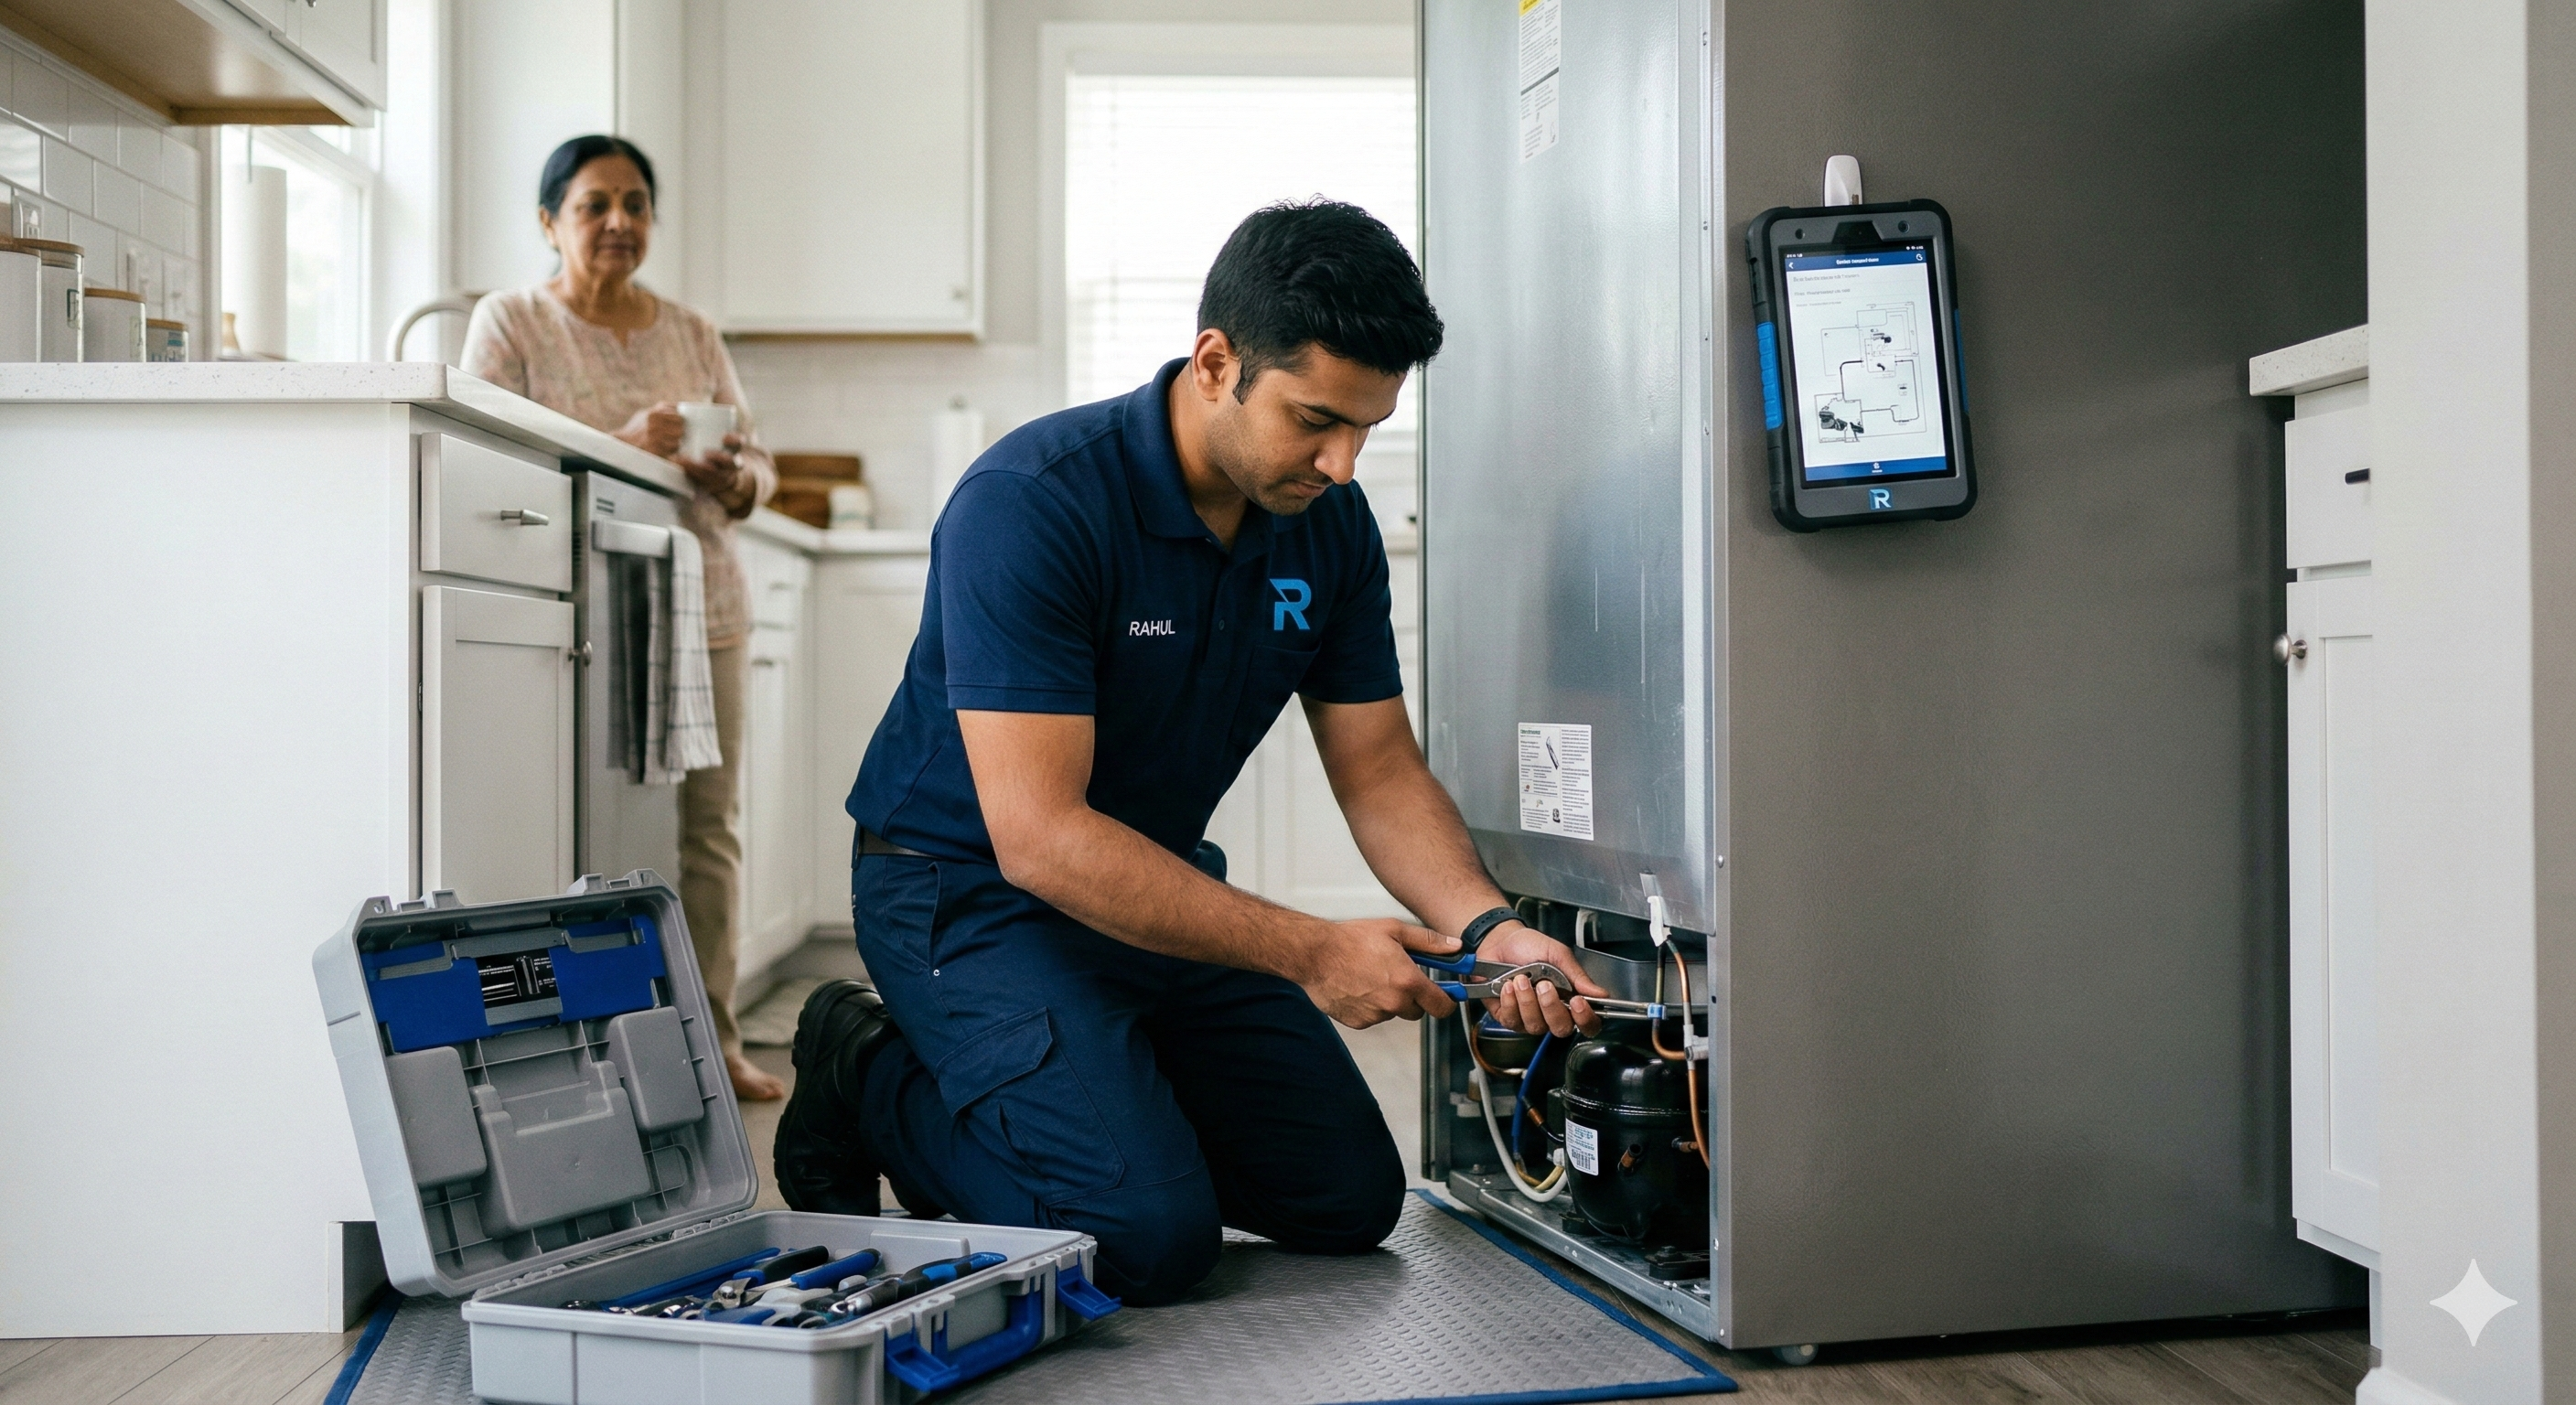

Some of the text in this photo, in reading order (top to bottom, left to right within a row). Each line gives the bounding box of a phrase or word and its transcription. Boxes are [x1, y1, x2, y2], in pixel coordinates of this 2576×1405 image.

[1870, 488, 1892, 509] R
[1269, 578, 1312, 631] R
[1129, 619, 1176, 637] RAHUL
